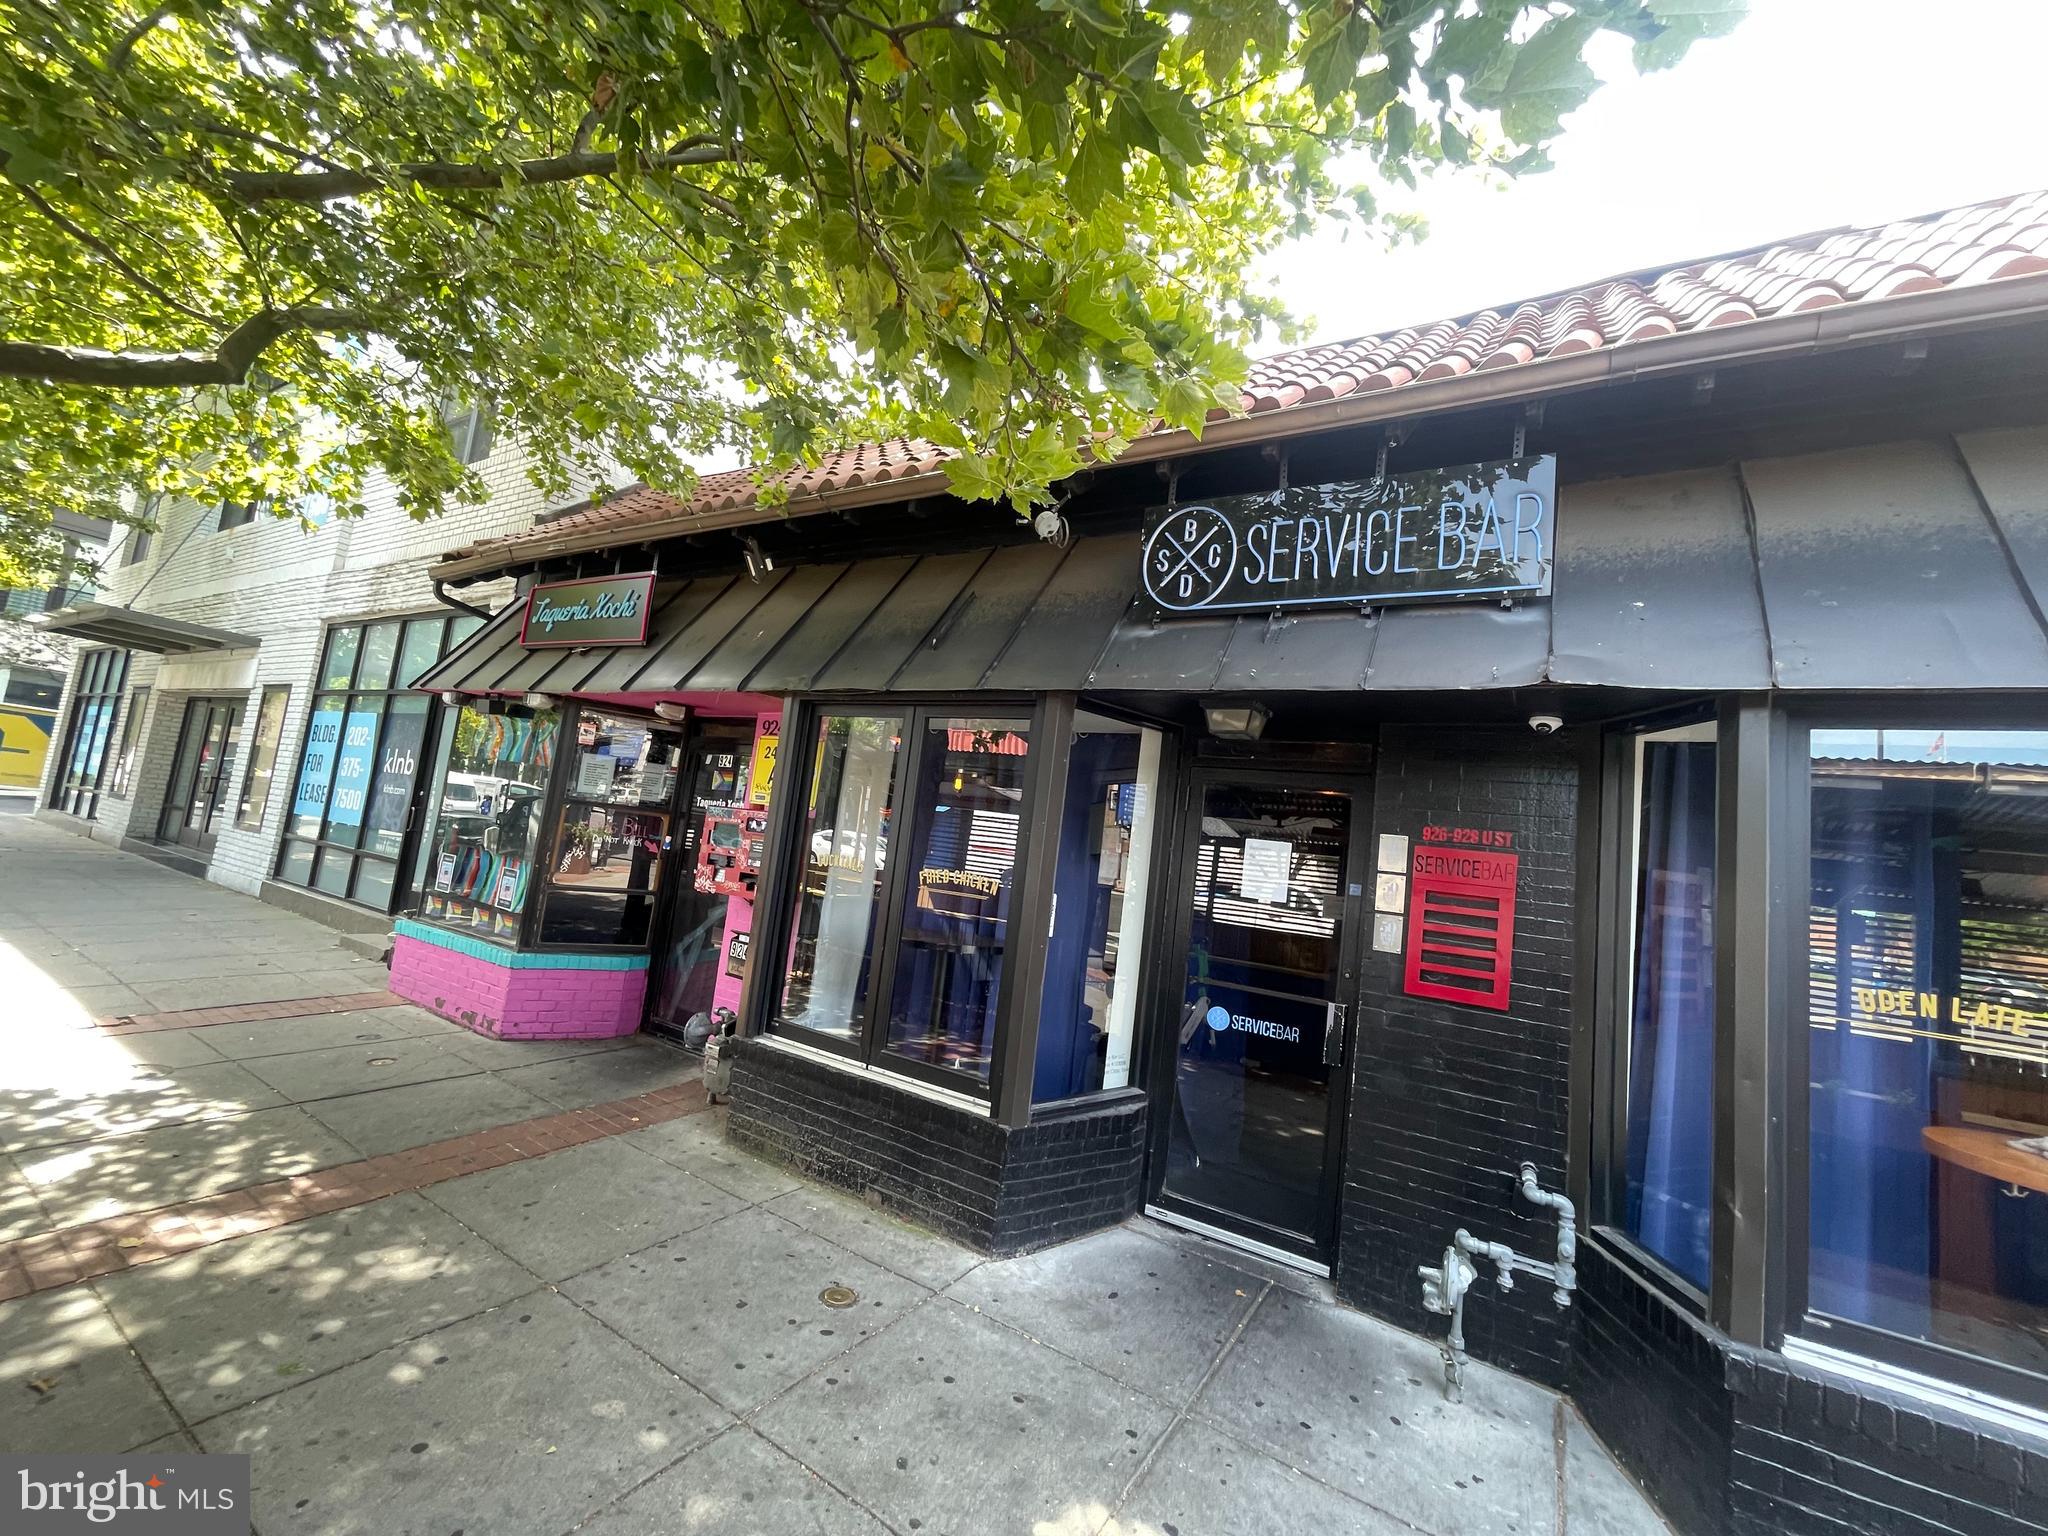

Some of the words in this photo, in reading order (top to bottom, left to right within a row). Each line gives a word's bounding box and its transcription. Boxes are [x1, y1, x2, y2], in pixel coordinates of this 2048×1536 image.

[1184, 519, 1197, 542] B
[1243, 505, 1422, 585] SERVICE
[1438, 493, 1544, 571] BAR
[590, 589, 641, 618] Xochi
[311, 724, 336, 743] BLDG.
[347, 726, 370, 746] 202-
[762, 720, 780, 736] 92
[305, 754, 323, 772] FOR
[341, 757, 364, 778] 375-
[383, 748, 414, 775] klnb
[299, 783, 327, 803] LEASE
[335, 788, 361, 810] 7500
[696, 797, 726, 809] Taqueria
[1423, 826, 1479, 844] 926-928
[1482, 830, 1493, 845] U
[1494, 831, 1513, 848] ST
[817, 853, 864, 873] COCKTAILS
[919, 868, 950, 885] FRIED
[954, 869, 1001, 896] CHICKEN
[1856, 987, 1938, 1019] OPEN
[1952, 997, 2034, 1038] LATE
